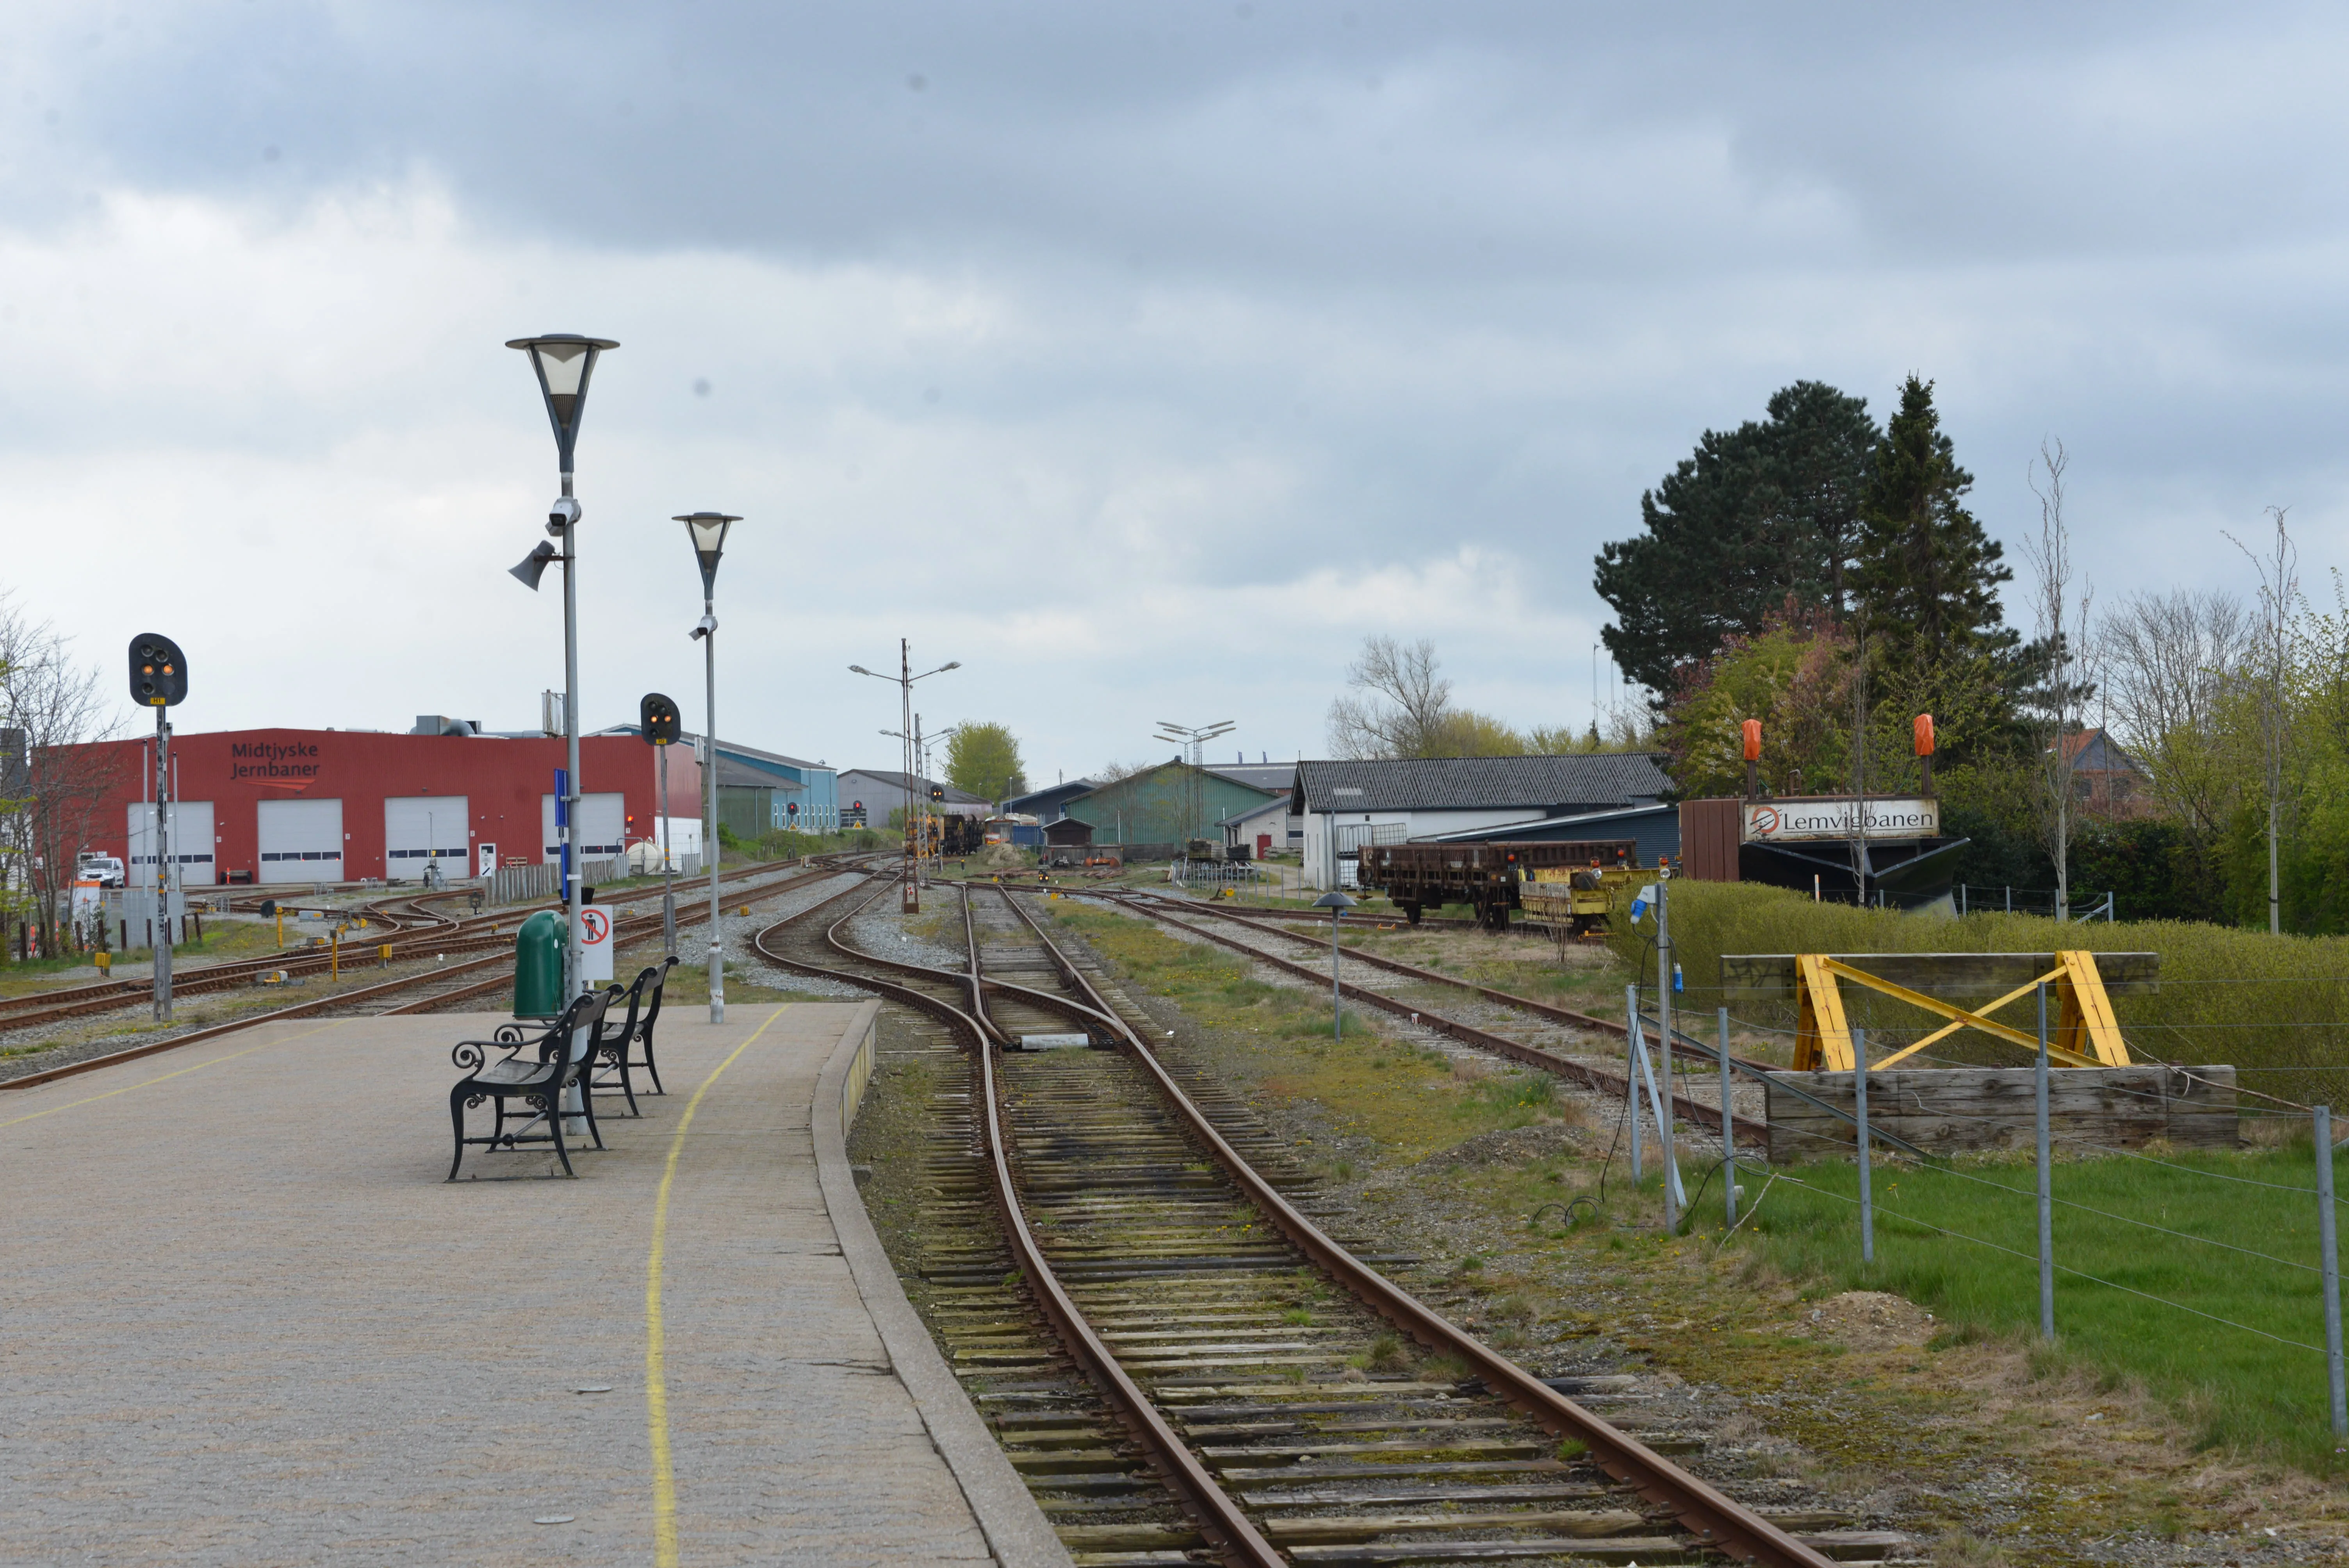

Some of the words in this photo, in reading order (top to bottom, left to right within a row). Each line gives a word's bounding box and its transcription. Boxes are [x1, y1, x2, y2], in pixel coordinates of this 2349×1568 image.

[232, 742, 318, 760] Midtjyske
[230, 761, 320, 780] Jernbaner
[1784, 810, 1933, 832] Lemvigbanen
